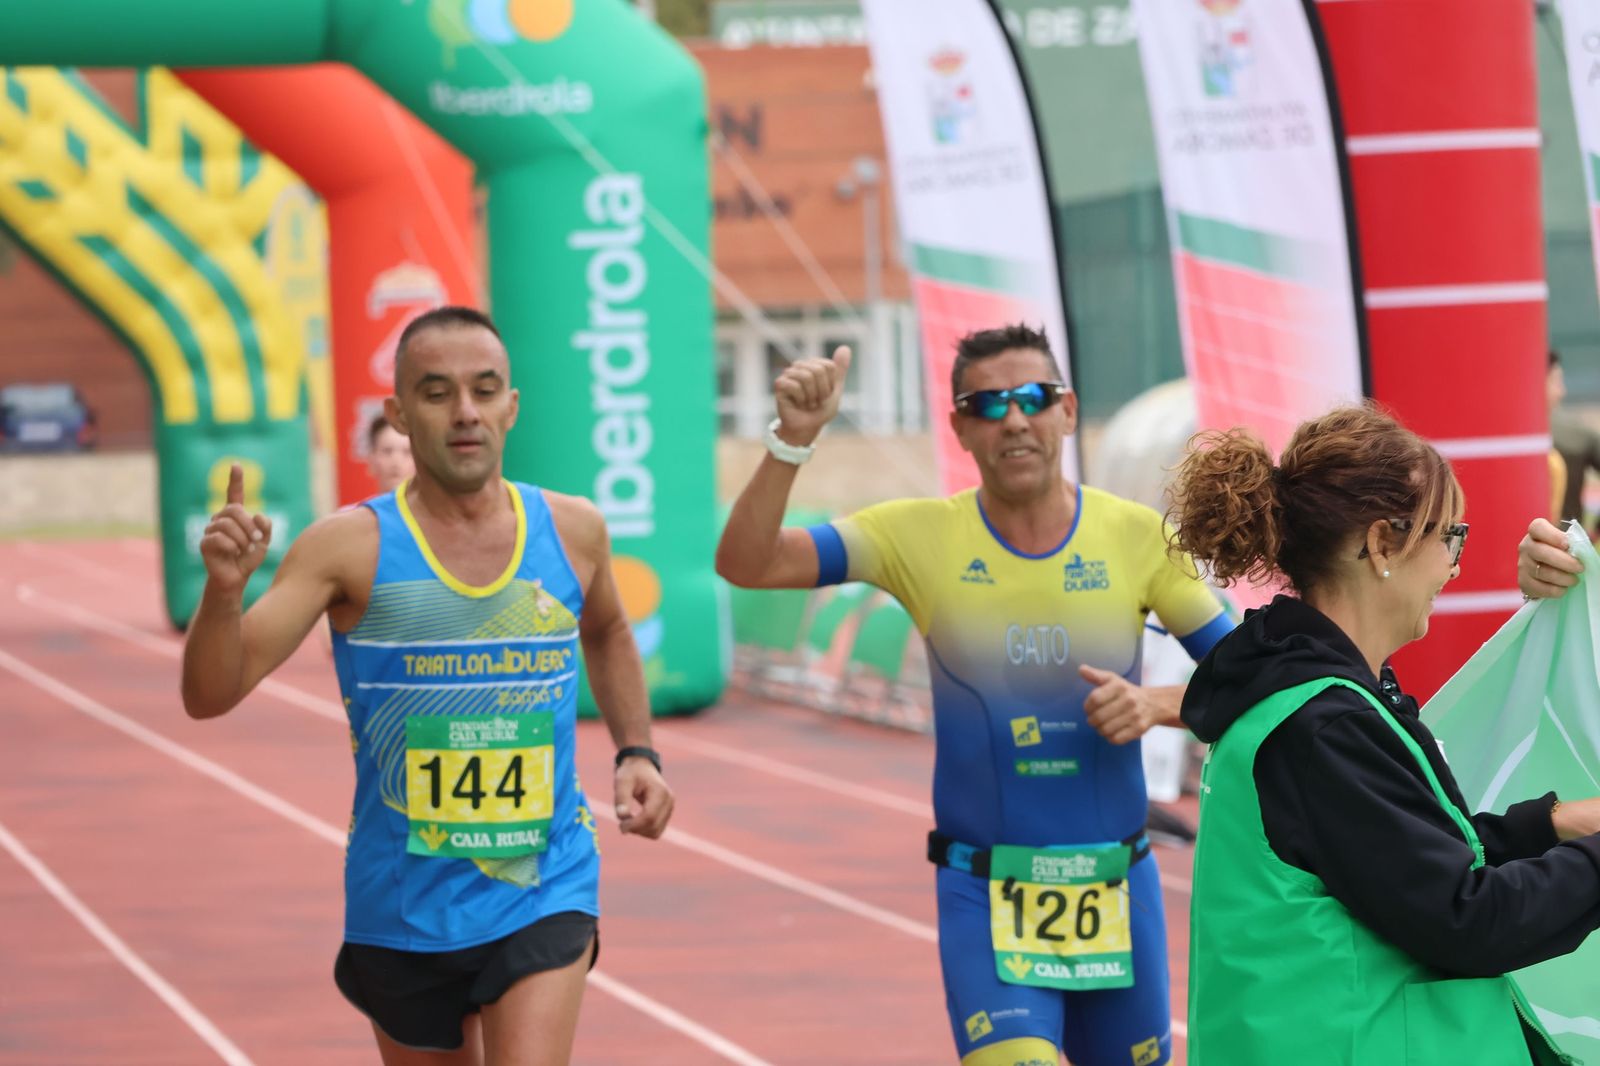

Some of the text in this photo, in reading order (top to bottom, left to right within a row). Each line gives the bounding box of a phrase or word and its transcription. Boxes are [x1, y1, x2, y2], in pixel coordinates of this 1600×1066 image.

[429, 82, 594, 115] Iberdrola
[567, 172, 655, 538] Iberdrola
[1006, 624, 1070, 666] GATO
[404, 653, 493, 675] TRIATLON
[419, 755, 526, 810] 144
[450, 829, 541, 848] CAJA RURAL
[1003, 887, 1100, 941] 126
[1034, 961, 1126, 979] CAJA RURAL
